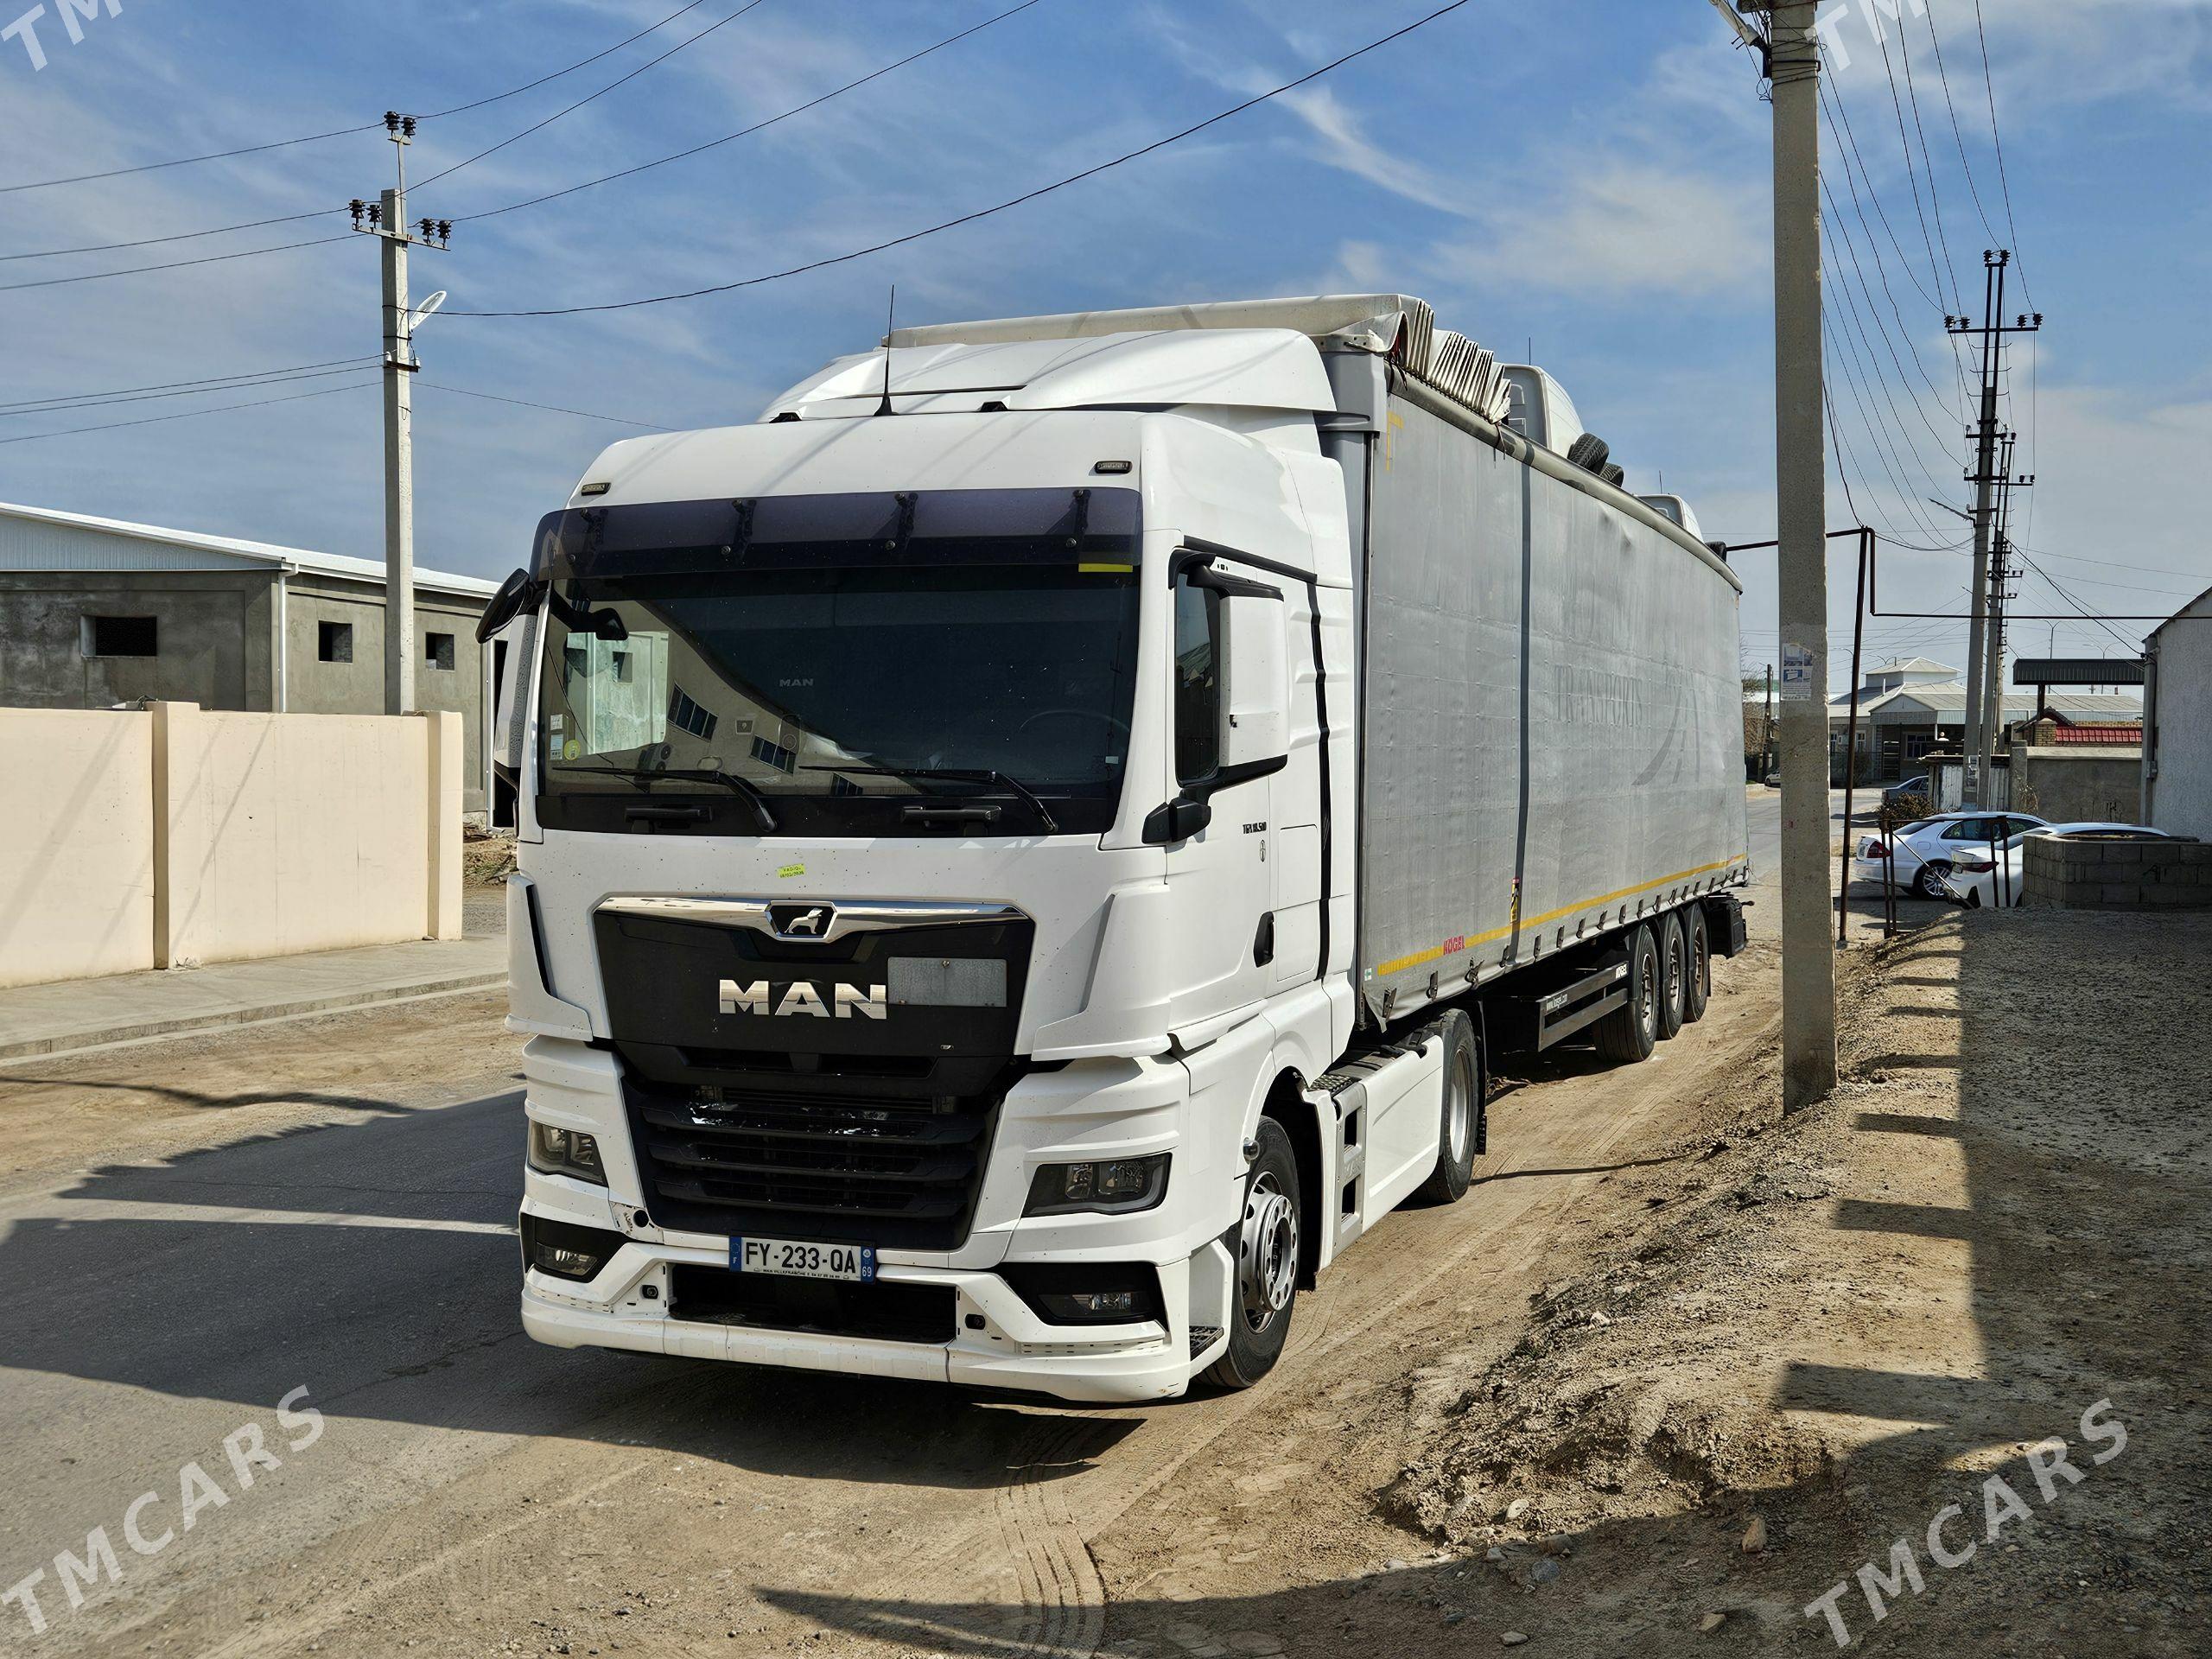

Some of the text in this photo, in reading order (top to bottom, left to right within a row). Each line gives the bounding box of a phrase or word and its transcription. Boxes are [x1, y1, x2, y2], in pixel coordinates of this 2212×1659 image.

[779, 678, 813, 687] MAN
[720, 979, 887, 1020] MAN
[746, 1242, 855, 1274] FY-233-QA
[862, 1266, 872, 1277] 69
